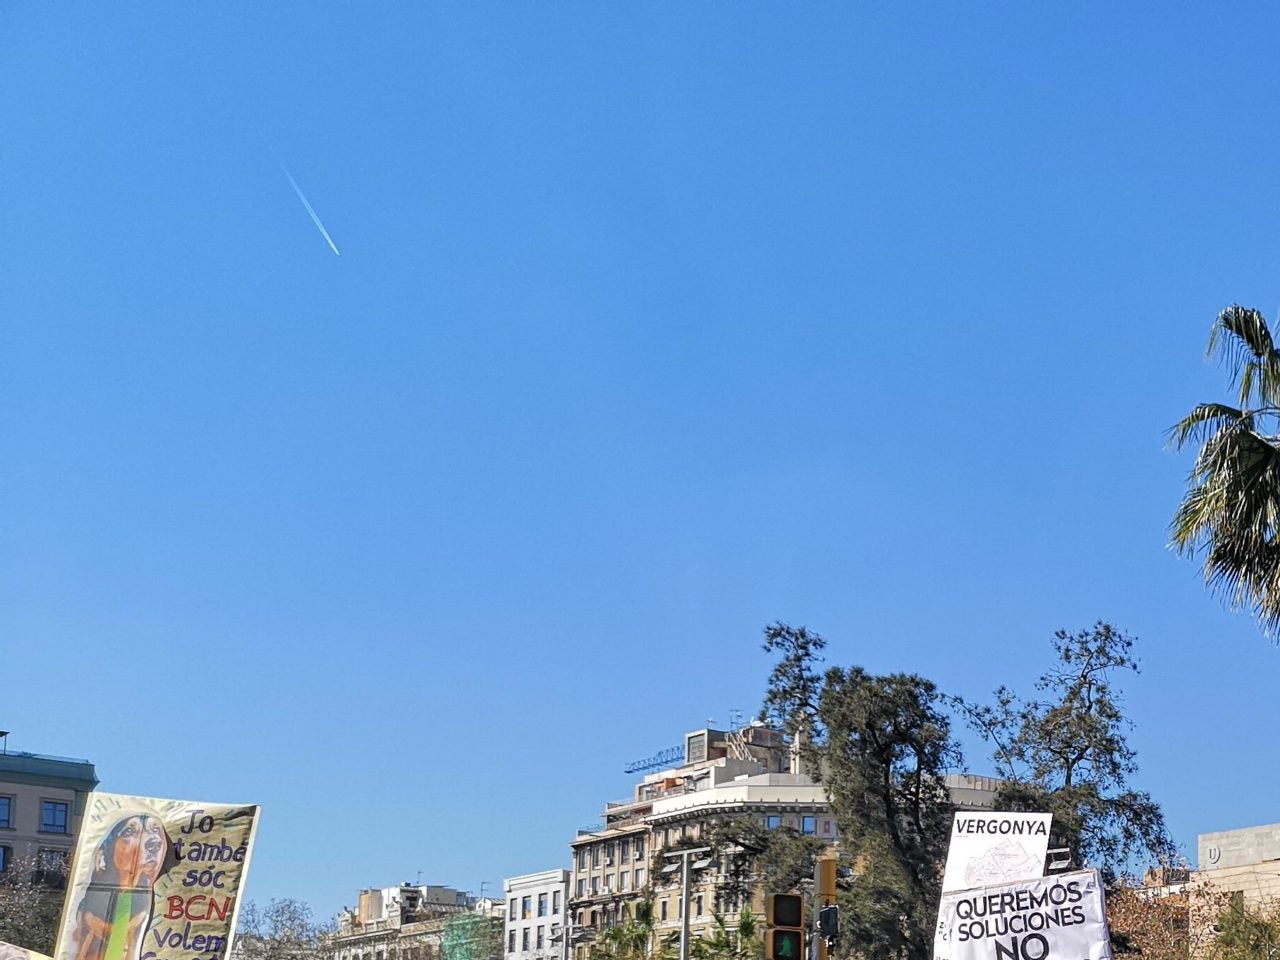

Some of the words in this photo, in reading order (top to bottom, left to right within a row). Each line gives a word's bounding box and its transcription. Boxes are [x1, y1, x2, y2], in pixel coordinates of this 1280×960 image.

[180, 810, 215, 834] Jo
[956, 819, 1047, 836] VERGONYA
[164, 895, 231, 921] BCN
[956, 882, 1082, 919] QUEREMOS
[958, 906, 1085, 941] SOLUCIONES
